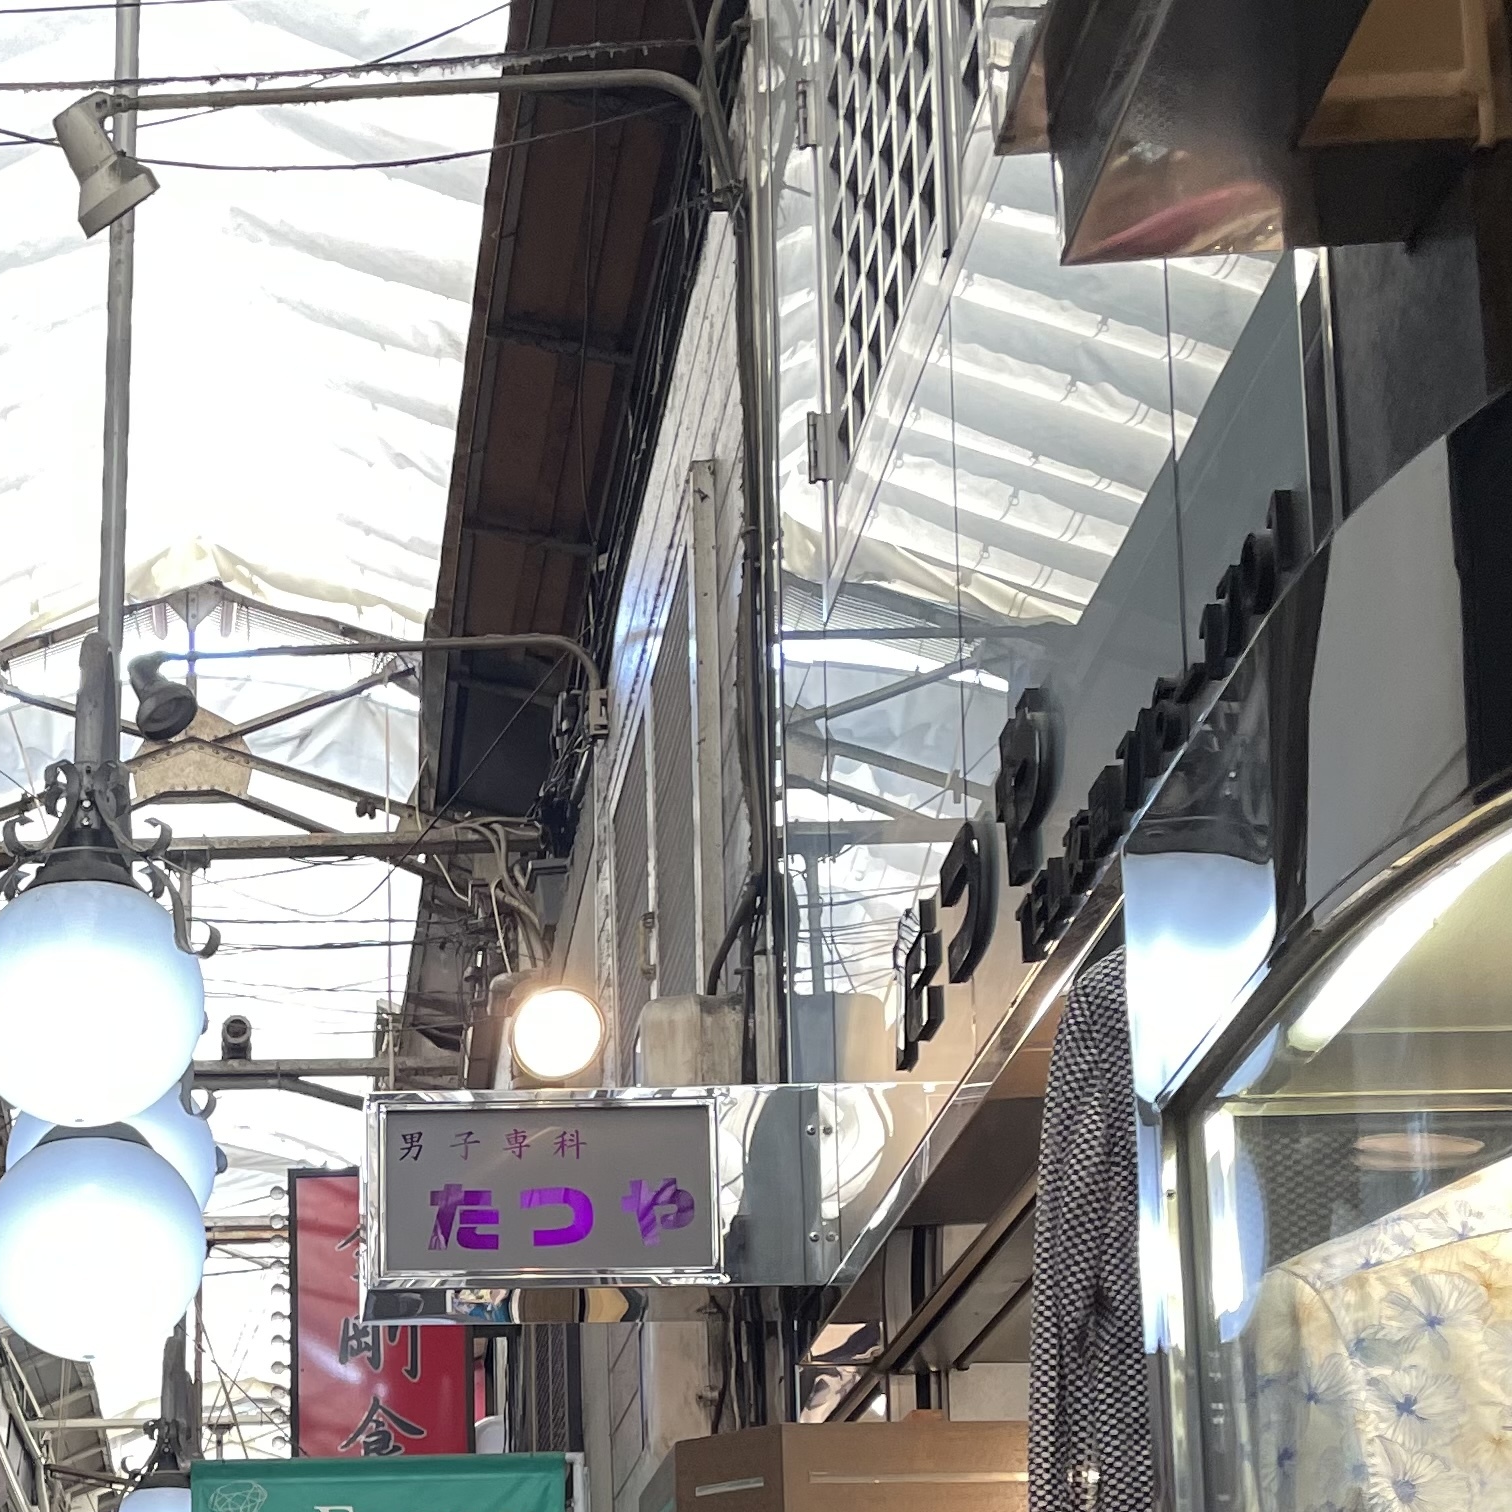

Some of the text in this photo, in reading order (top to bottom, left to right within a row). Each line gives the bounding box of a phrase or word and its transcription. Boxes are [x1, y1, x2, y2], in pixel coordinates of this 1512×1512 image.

[399, 1128, 587, 1161] 男子専科
[428, 1177, 695, 1250] たつや
